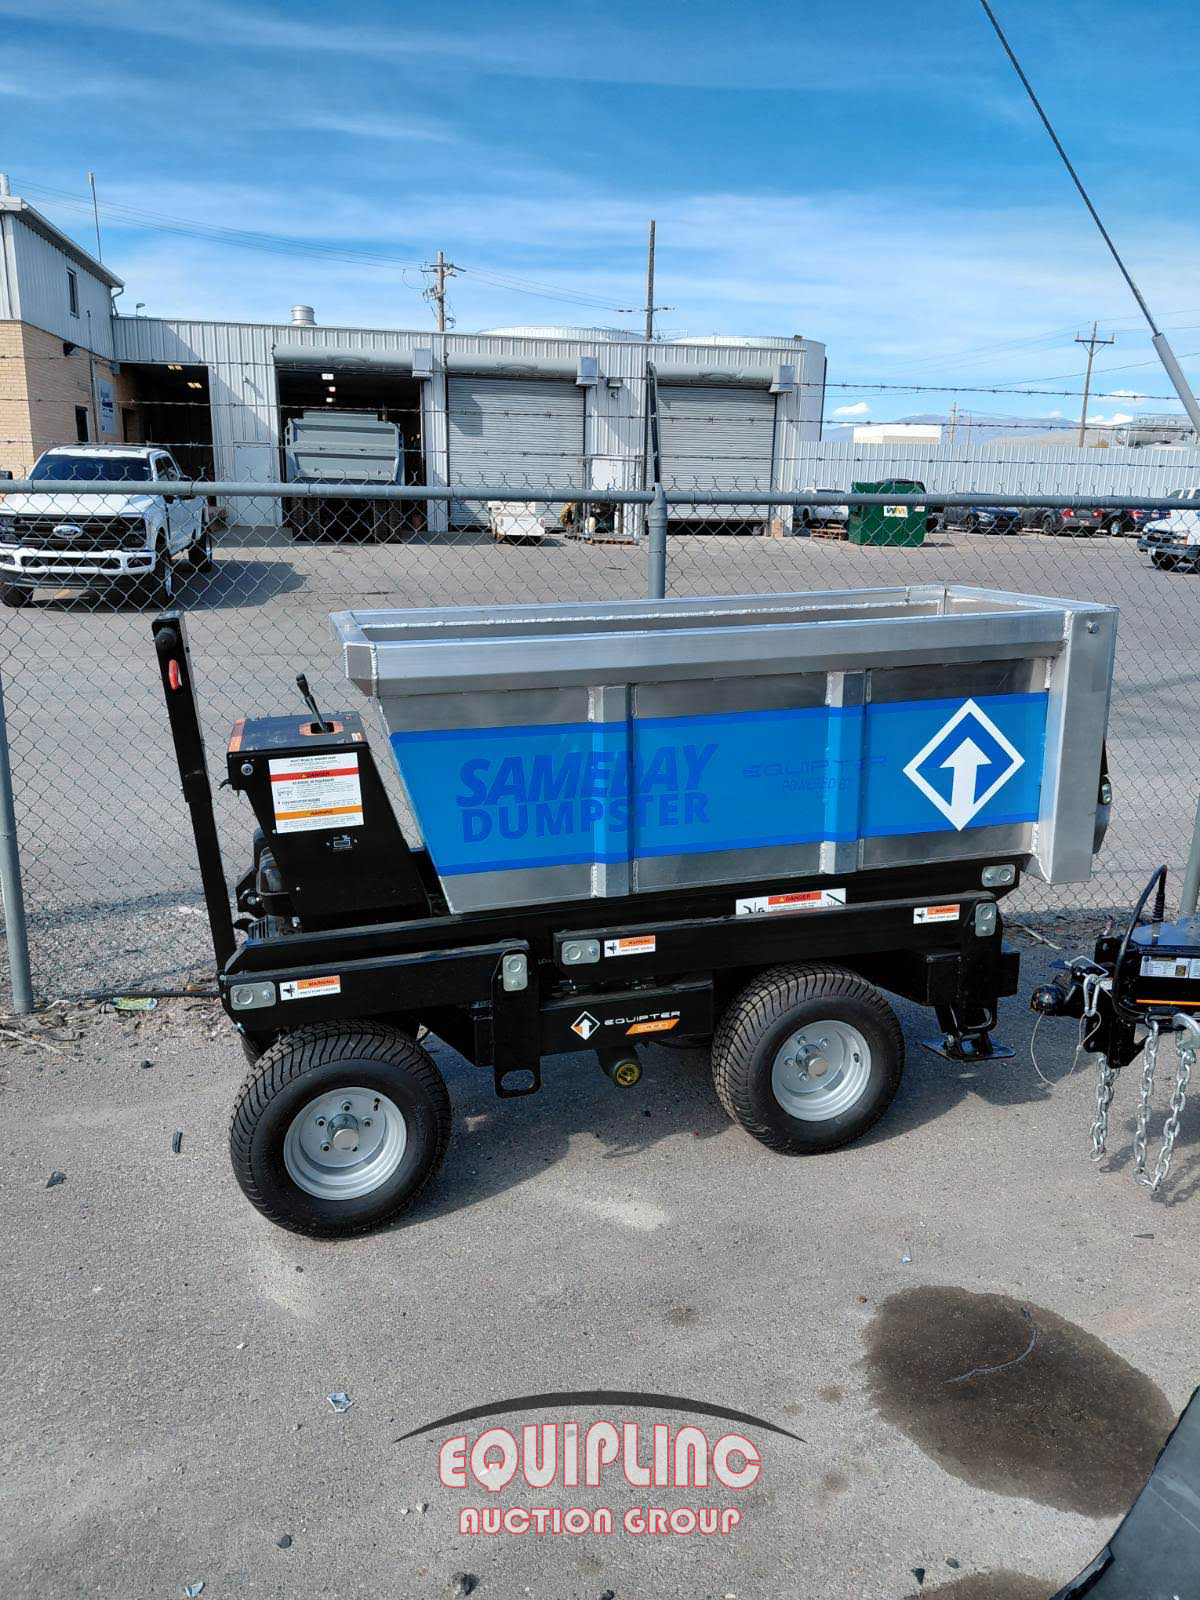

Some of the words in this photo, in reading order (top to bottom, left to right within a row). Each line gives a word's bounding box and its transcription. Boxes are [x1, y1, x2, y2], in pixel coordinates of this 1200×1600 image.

[456, 744, 719, 807] SAMEDAY
[743, 756, 887, 778] EQUIPTER
[463, 791, 711, 843] DUMPSTER
[604, 1011, 680, 1026] EQUIPTER
